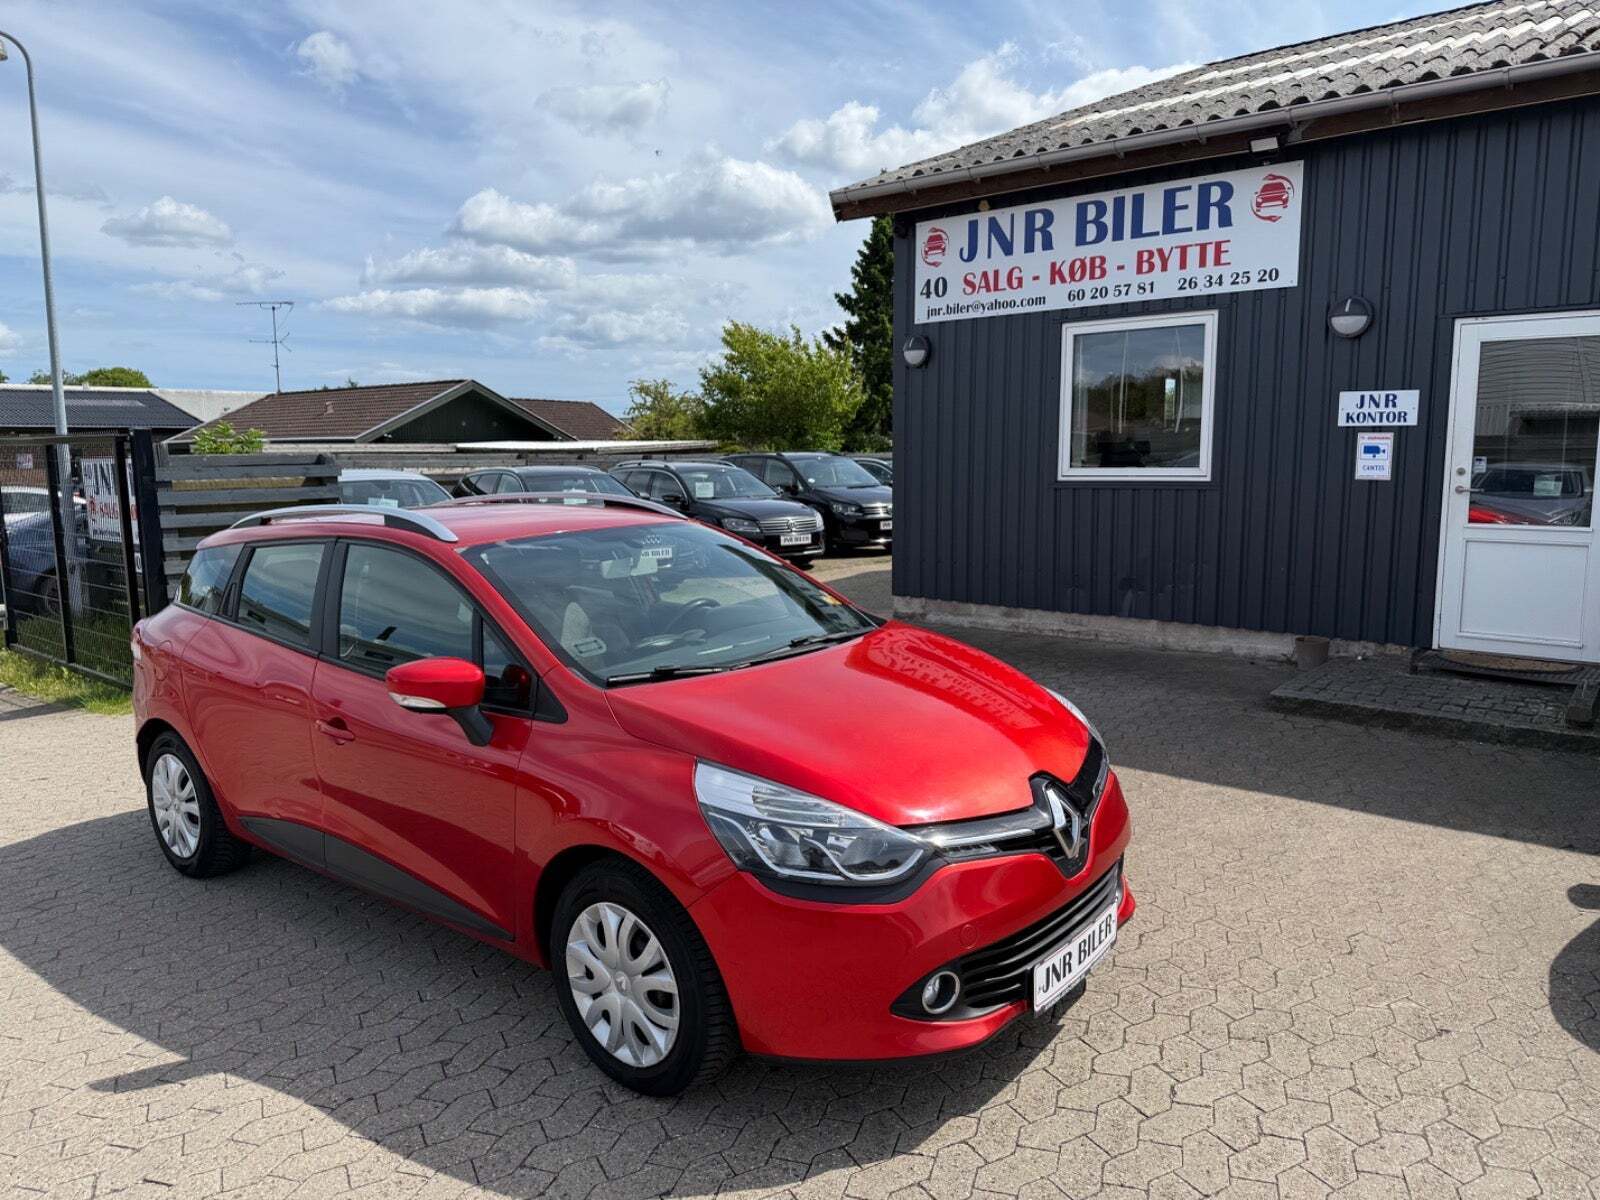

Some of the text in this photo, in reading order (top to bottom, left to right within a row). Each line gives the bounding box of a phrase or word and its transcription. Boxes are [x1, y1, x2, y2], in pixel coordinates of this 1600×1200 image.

[959, 180, 1235, 263] JNR BILER
[963, 240, 1232, 295] SALG - KØB - BYTTE
[920, 276, 948, 299] 40
[1177, 268, 1280, 291] 26 34 25 20
[1068, 281, 1155, 302] 60 20 57 81
[927, 295, 1046, 320] jnr.biler@yahoo.com
[1356, 393, 1398, 409] JNR
[1346, 411, 1408, 423] KONTOR
[1042, 913, 1112, 993] JNR BILER
